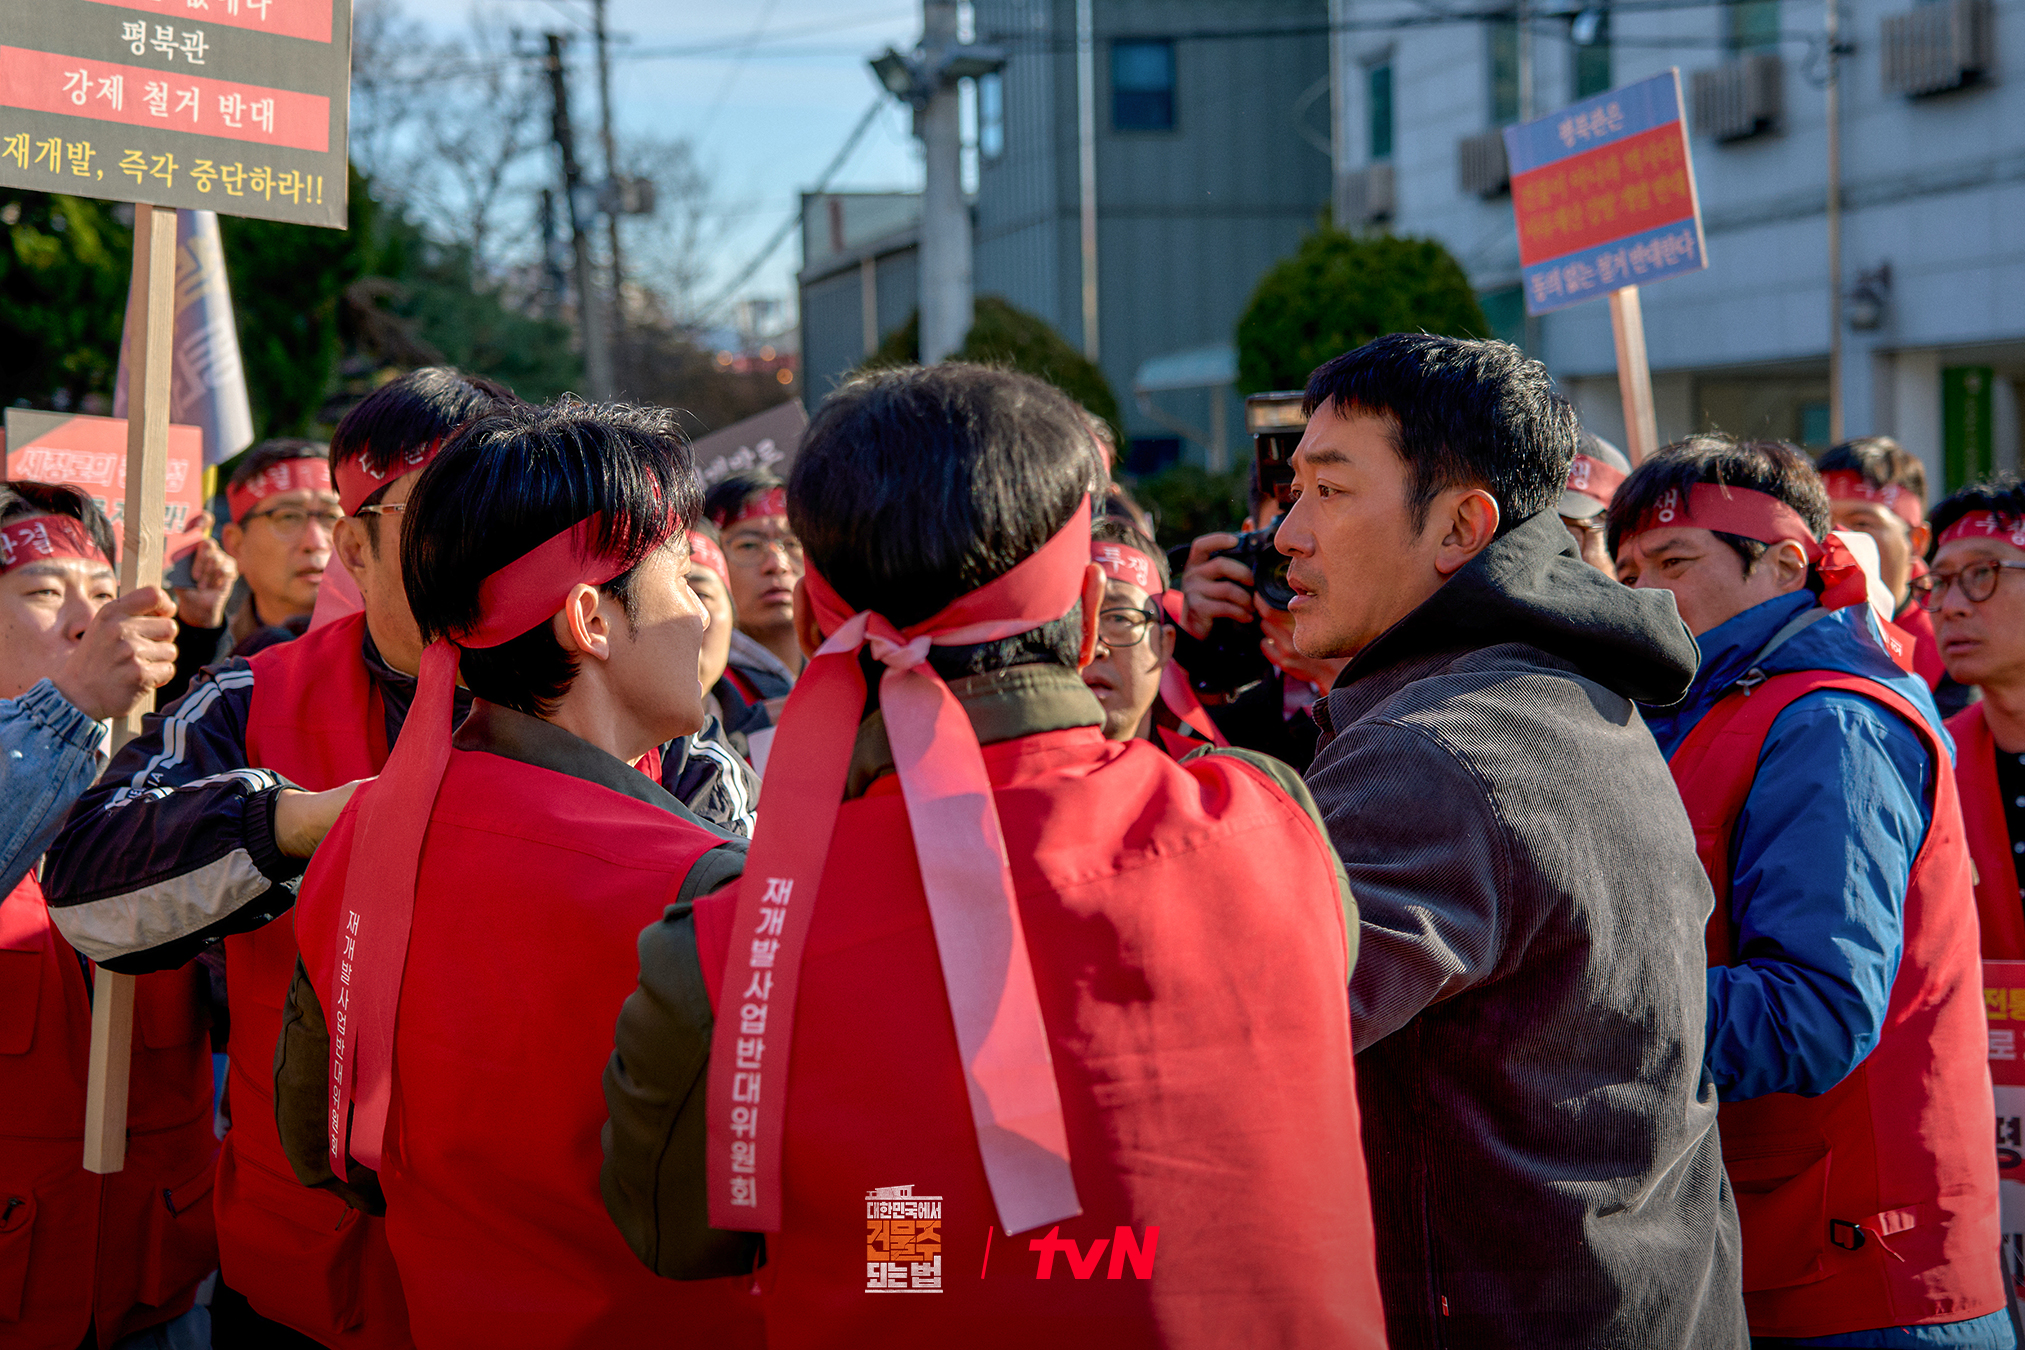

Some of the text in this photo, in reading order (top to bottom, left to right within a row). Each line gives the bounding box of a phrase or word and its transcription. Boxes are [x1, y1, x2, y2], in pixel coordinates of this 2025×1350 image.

[121, 19, 210, 65] 평북관
[62, 68, 276, 134] 강제 철거 반대
[1, 132, 323, 205] 재개발, 즉각 중단하라!!
[729, 876, 794, 1208] 재개발사업반대위원회
